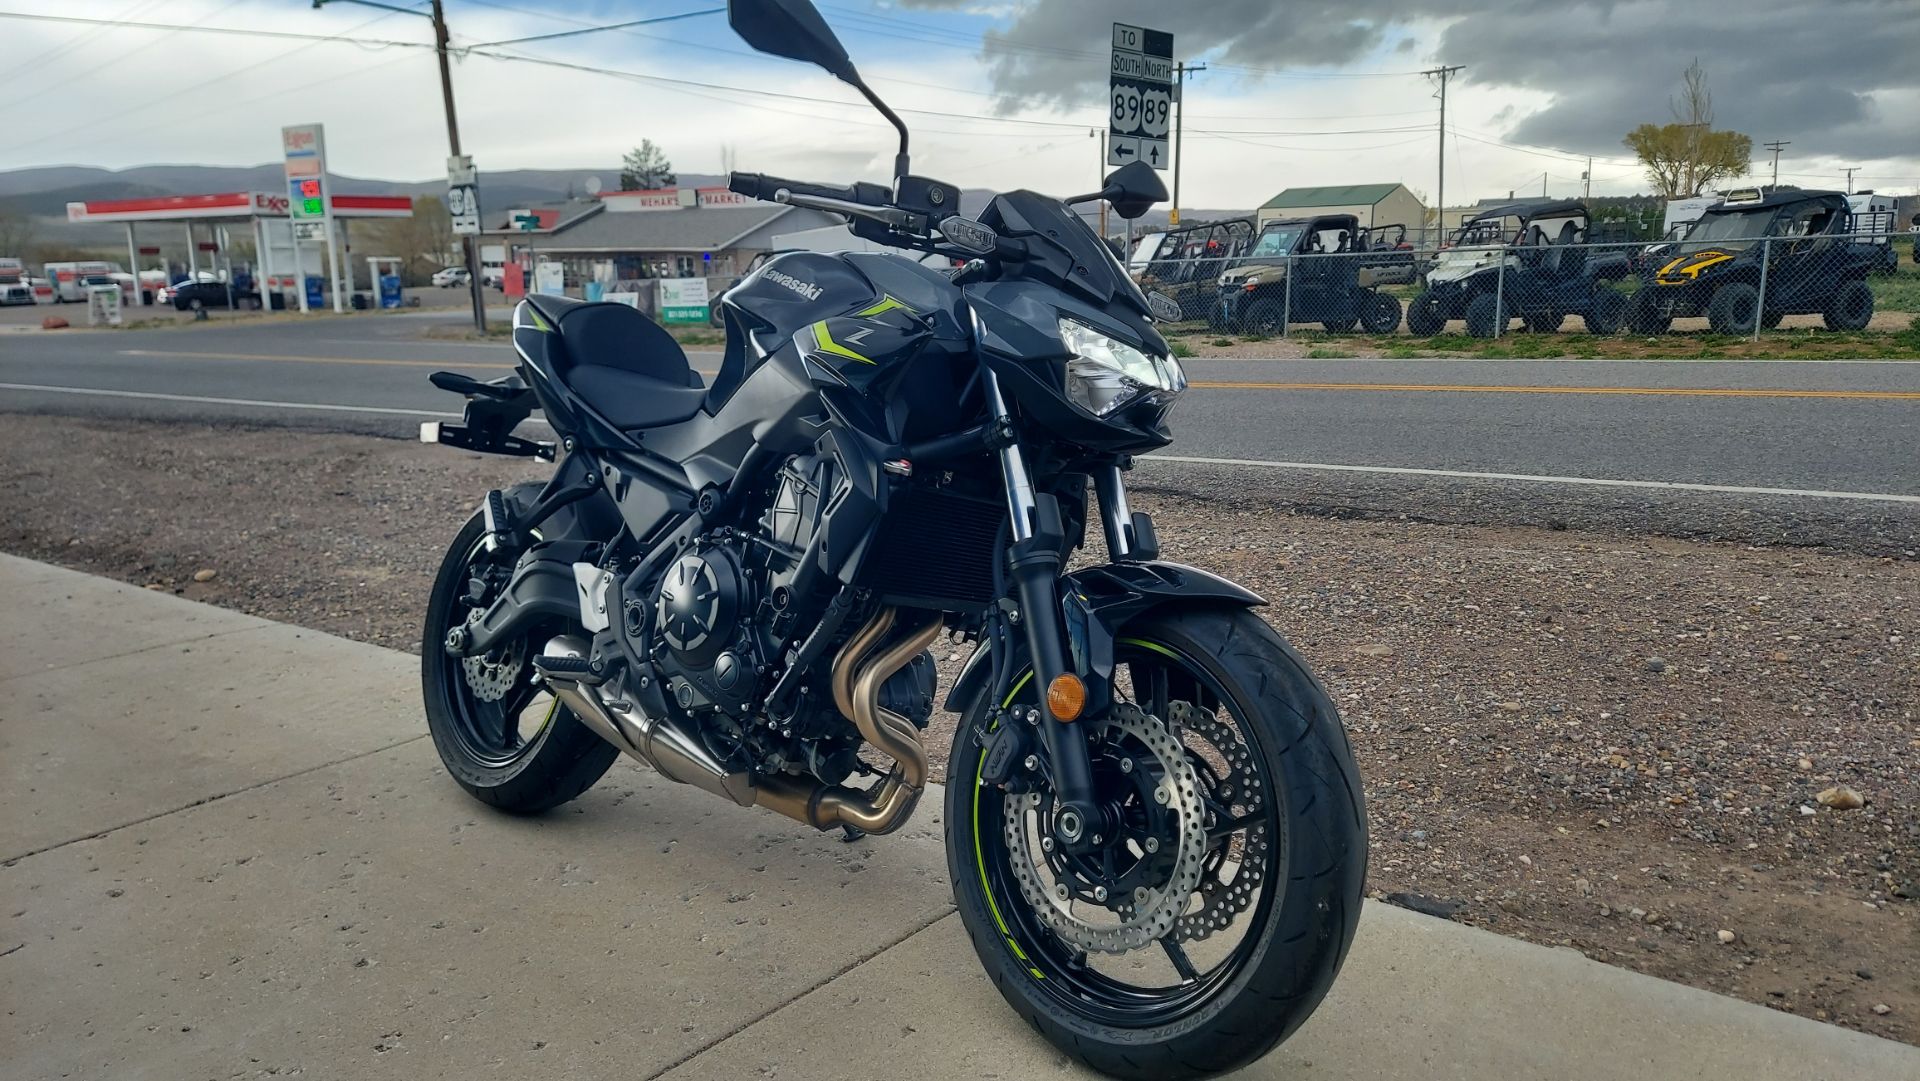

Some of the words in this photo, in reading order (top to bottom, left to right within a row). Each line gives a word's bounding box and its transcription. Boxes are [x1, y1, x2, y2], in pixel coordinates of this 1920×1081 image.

[1121, 29, 1136, 46] TO
[1114, 54, 1141, 78] SOUTH
[1144, 58, 1171, 79] NORTH
[1114, 93, 1139, 121] 89
[1144, 98, 1168, 125] 89
[705, 193, 747, 205] MARKET
[759, 265, 824, 301] Kawasaki
